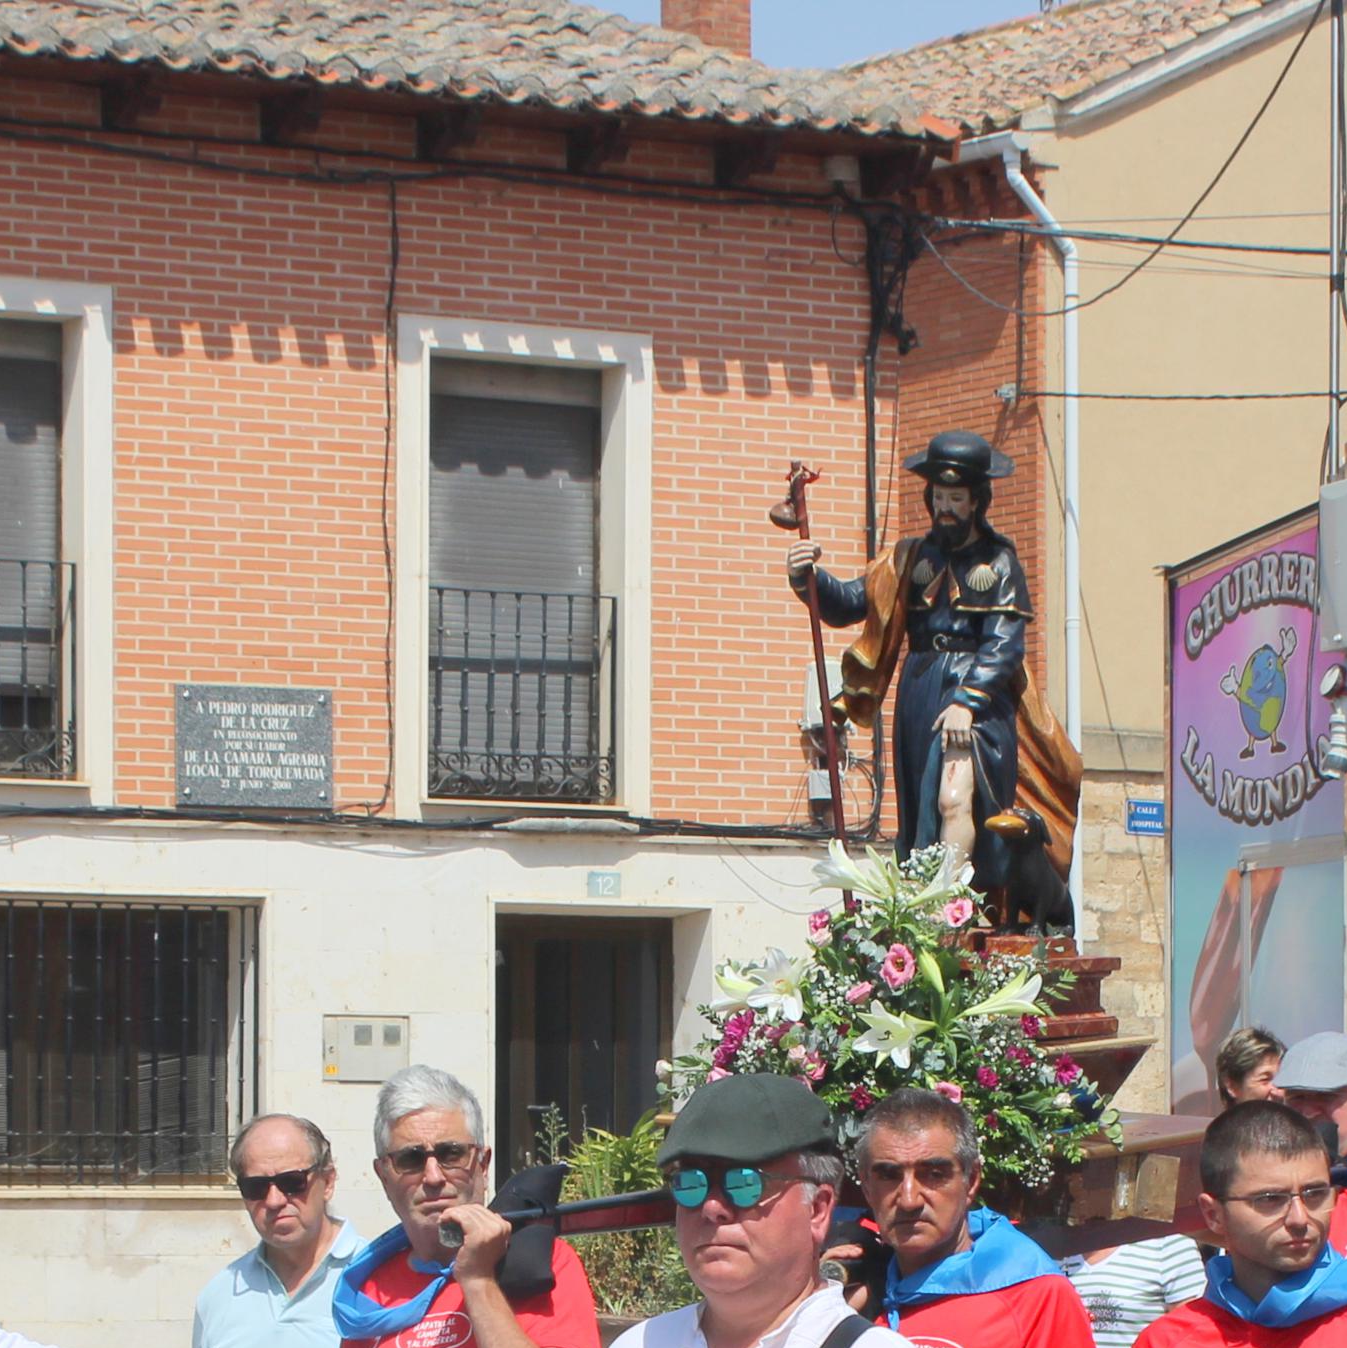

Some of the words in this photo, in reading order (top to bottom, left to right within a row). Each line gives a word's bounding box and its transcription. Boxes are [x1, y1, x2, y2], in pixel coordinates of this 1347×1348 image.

[1184, 551, 1322, 660] CHURRER
[195, 701, 204, 714] A
[208, 702, 247, 716] PEDRO
[251, 702, 316, 718] RODRIGUEZ
[221, 715, 237, 729] DE
[241, 716, 256, 730] LA
[260, 717, 290, 731] CRUZ
[227, 730, 298, 742] RECONOCIMIENTO
[225, 741, 242, 751] POR
[184, 750, 198, 763] DE
[204, 750, 219, 763] LA
[224, 751, 272, 765] CAMARA
[277, 752, 327, 767] AGRARIA
[1181, 726, 1216, 806] LA
[185, 764, 222, 777] LOCAL
[226, 765, 242, 778] DE
[247, 766, 325, 781] TORQUEMADA
[595, 876, 615, 896] 12
